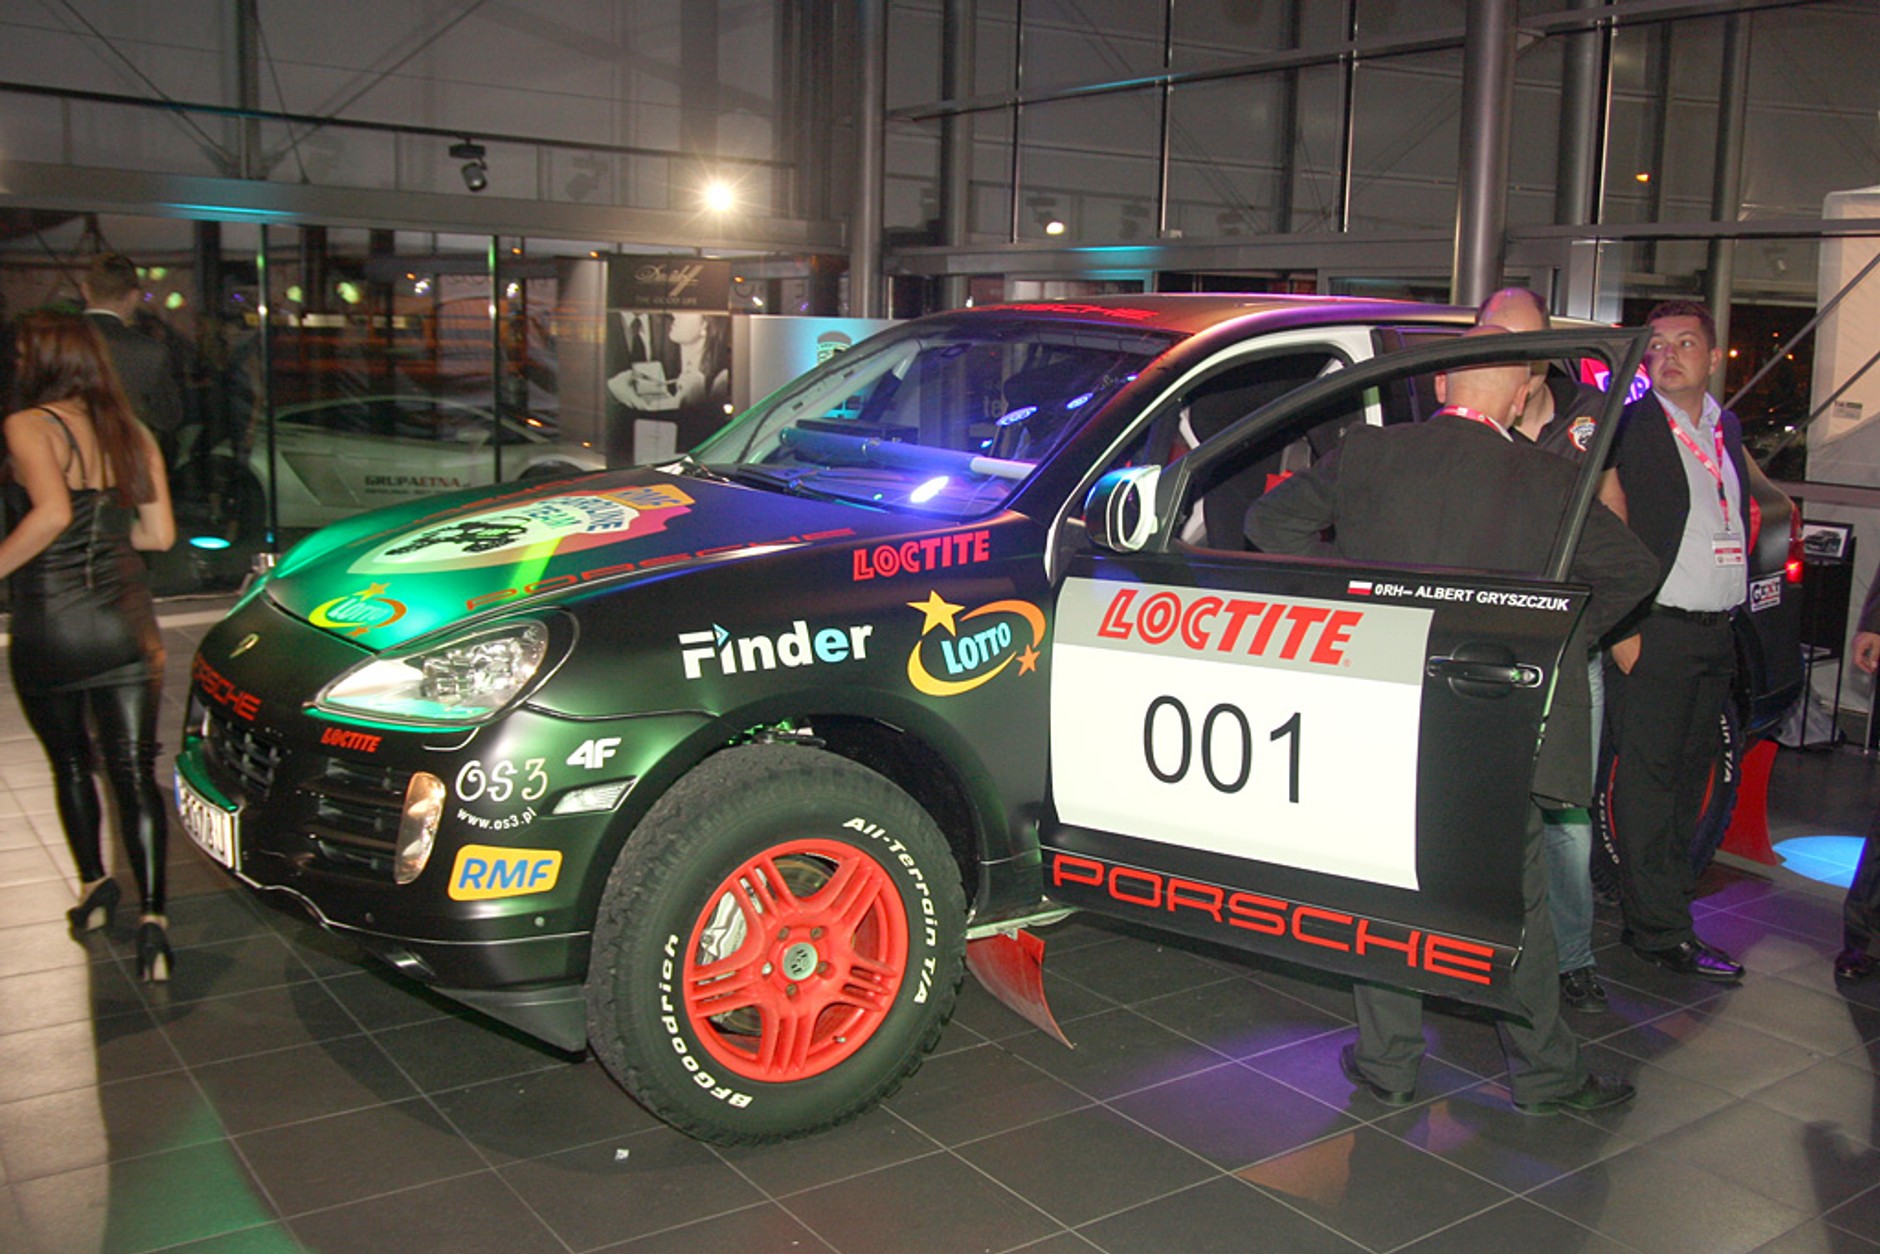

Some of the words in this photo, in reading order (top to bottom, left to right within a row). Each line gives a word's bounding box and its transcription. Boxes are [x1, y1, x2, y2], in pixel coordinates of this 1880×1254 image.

[852, 530, 990, 582] LOCTITE
[1414, 585, 1475, 602] ALBERT
[1476, 591, 1570, 611] GRYSZCZUK
[678, 620, 873, 680] Finder
[941, 622, 1012, 675] LOTTO
[1097, 588, 1364, 666] LOCTITE
[320, 728, 382, 753] LOCTITE
[566, 738, 622, 769] 4F
[1143, 694, 1302, 804] 001
[456, 807, 537, 831] www.os3.pl
[458, 859, 553, 890] RMF
[842, 816, 938, 947] All-Terrain
[914, 957, 936, 1004] T/A
[1052, 853, 1496, 986] PORSCHE
[659, 934, 753, 1109] BFGoodrich
